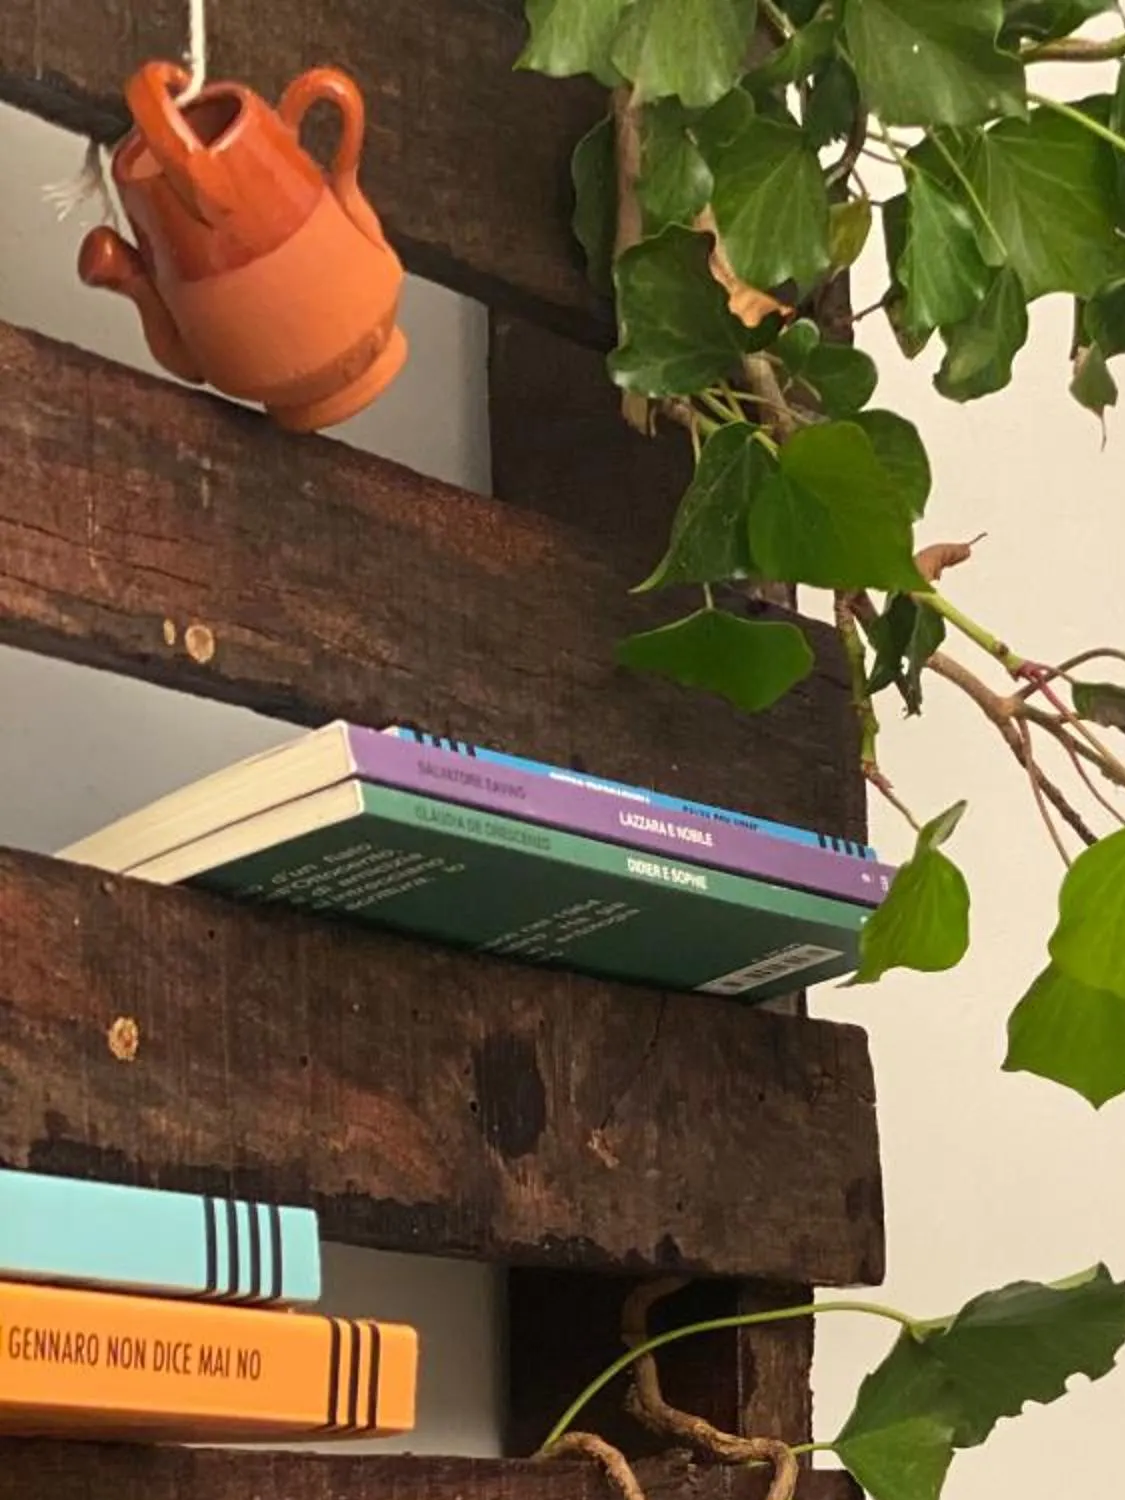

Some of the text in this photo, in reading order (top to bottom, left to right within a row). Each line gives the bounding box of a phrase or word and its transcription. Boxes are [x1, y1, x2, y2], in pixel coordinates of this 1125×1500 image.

[415, 804, 465, 829] CLAUDIA
[619, 809, 667, 836] LAZZARA
[666, 823, 677, 838] E
[676, 825, 713, 847] NOBILE
[626, 857, 708, 890] DIDIER E SOPHIE
[8, 1325, 99, 1367] GENNARO
[106, 1335, 147, 1370] NON
[152, 1339, 193, 1376] DICE
[197, 1343, 231, 1378] MAI
[236, 1347, 262, 1382] NO
